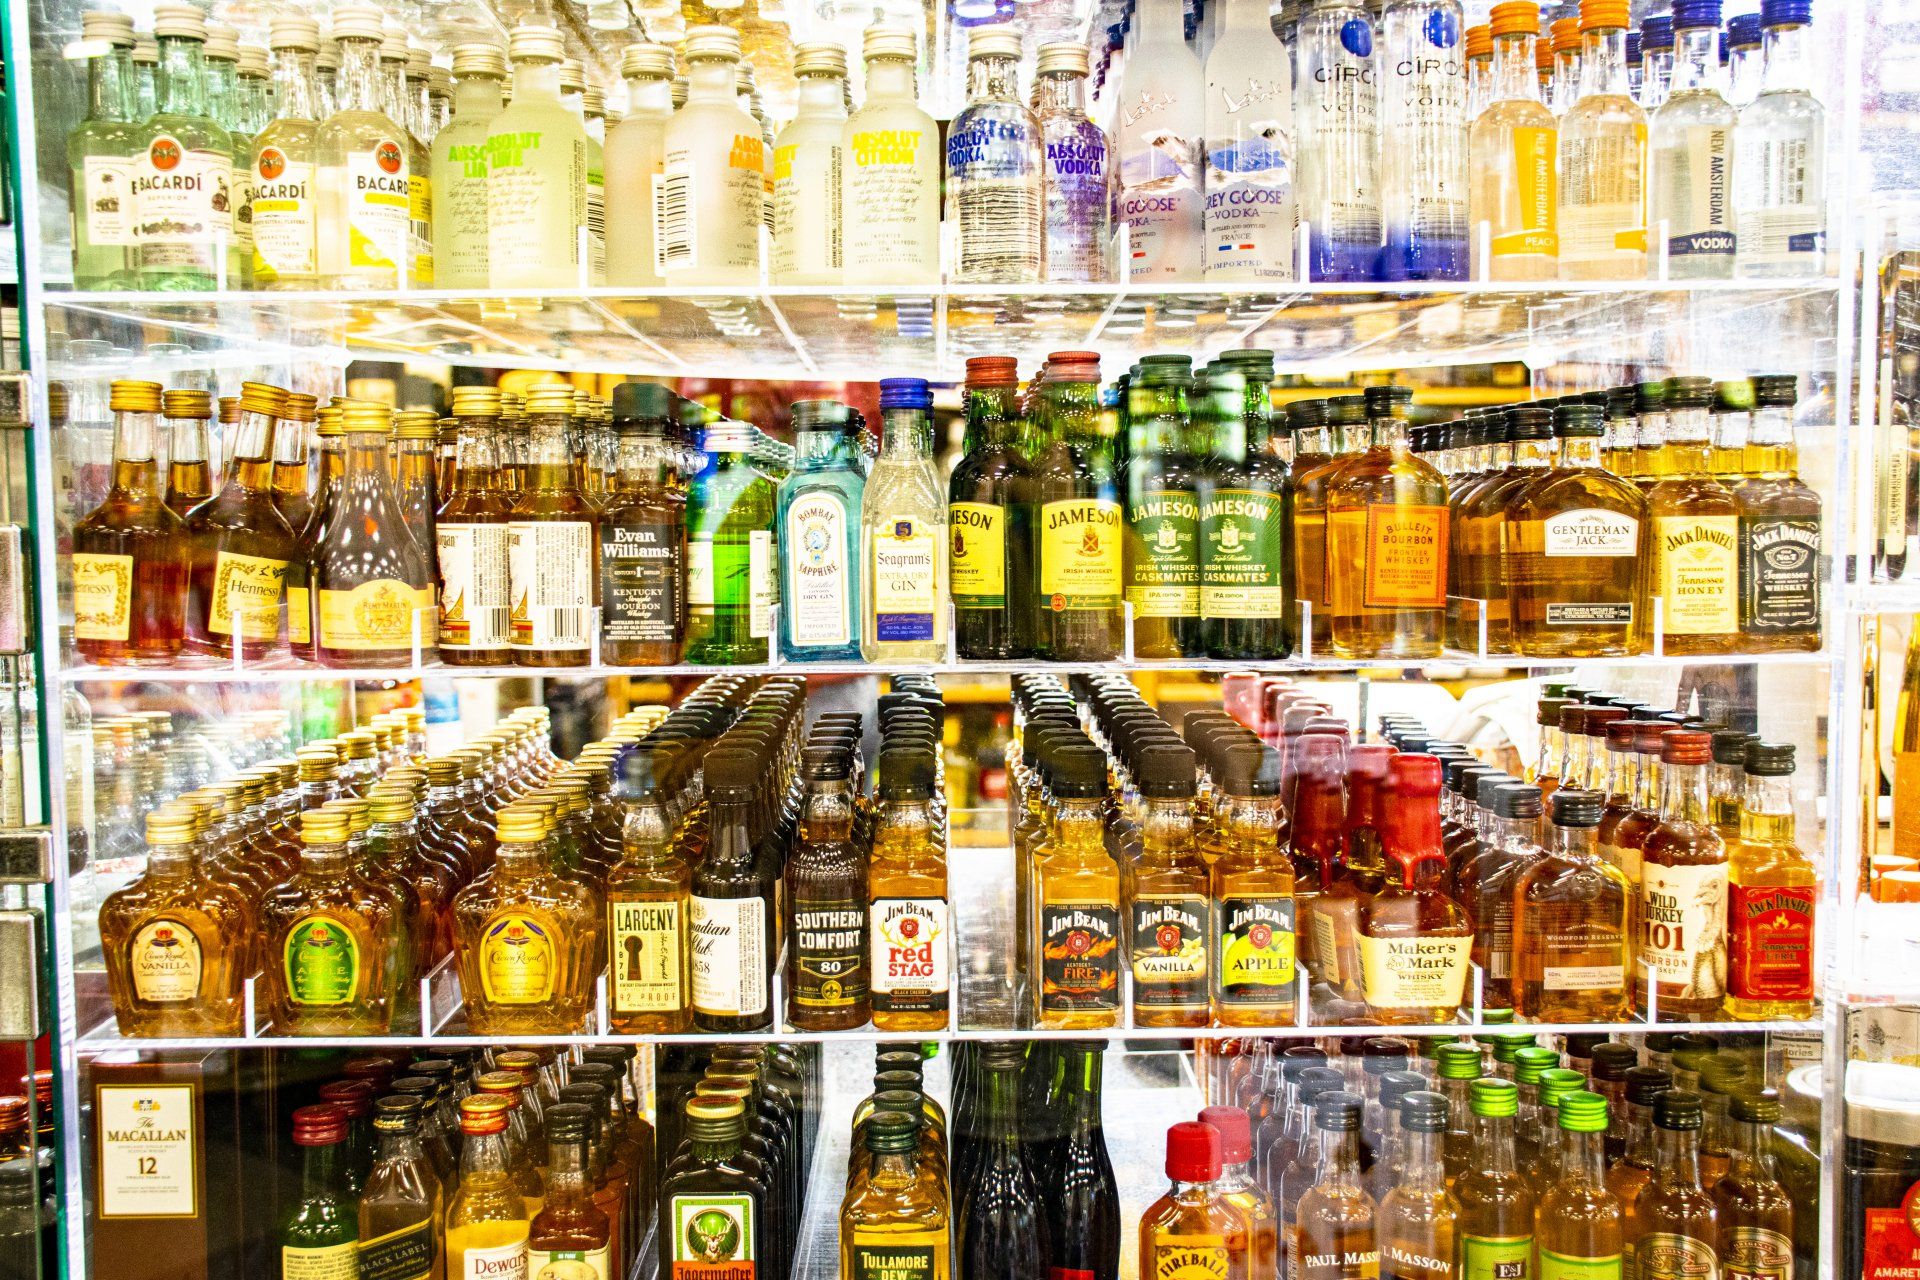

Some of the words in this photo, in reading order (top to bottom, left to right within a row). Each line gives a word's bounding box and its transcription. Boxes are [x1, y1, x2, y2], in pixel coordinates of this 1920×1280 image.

[851, 130, 922, 151] ABSOLUT
[1711, 130, 1725, 153] NEW
[448, 144, 488, 162] ABSO
[1047, 143, 1106, 162] ABSOLUT
[1055, 160, 1102, 176] VODKA
[356, 175, 408, 195] BACARD
[1710, 156, 1724, 226] AMSTERDAM
[1126, 196, 1176, 214] GOOSE
[1205, 192, 1227, 211] REY
[1229, 189, 1283, 205] GOOSE
[1214, 208, 1259, 219] VODKA
[1221, 232, 1251, 241] FRANCE
[1525, 236, 1554, 246] PEACH
[1691, 237, 1734, 250] VODKA
[1213, 260, 1262, 270] IMPORTED
[798, 508, 835, 522] BOMBAY
[1131, 501, 1200, 522] JAMESON
[1202, 500, 1269, 521] JAMESON
[1049, 508, 1119, 530] JAMESON
[614, 528, 657, 543] Evan
[1386, 522, 1432, 535] BULLEIT
[1552, 525, 1631, 535] GENTLEMAN
[1383, 536, 1433, 545] BOURBON
[1576, 536, 1607, 547] JACK
[1666, 530, 1694, 551] JACK
[1695, 525, 1734, 551] DANIEL'S
[1751, 530, 1779, 551] JACK
[1779, 524, 1820, 549] DANIEL'S
[878, 552, 931, 568] Seagram's
[1386, 557, 1430, 565] WHISKEY
[799, 561, 839, 576] SAPPHIRE
[1763, 570, 1809, 580] Tennessee
[880, 572, 907, 580] EXTRA
[911, 572, 929, 580] DRY
[1135, 572, 1200, 582] CASKMATES
[1203, 572, 1268, 583] CASKMATES
[1677, 574, 1724, 585] Tennessee
[613, 589, 664, 597] KENTUCKY
[891, 581, 917, 592] GIN
[1677, 586, 1724, 595] HONEY
[1764, 584, 1808, 592] WHISKEY
[616, 603, 661, 611] BOURBON
[368, 611, 402, 632] 1738
[1649, 891, 1677, 909] WILD
[885, 904, 904, 922] JIM
[906, 902, 933, 922] BEAM
[1645, 901, 1684, 923] TURKEY
[1747, 899, 1774, 918] JACK
[618, 909, 673, 931] LARCENY
[795, 911, 863, 930] SOUTHERN
[1048, 915, 1073, 938] JIM
[1073, 911, 1109, 937] BEAM
[1138, 910, 1162, 932] JIM
[1163, 906, 1199, 932] BEAM
[1229, 909, 1254, 932] JIM
[1255, 904, 1290, 930] BEAM
[799, 930, 860, 950] COMFORT
[1257, 932, 1264, 940] B
[1591, 933, 1623, 941] RESERVE
[1644, 921, 1685, 951] 101
[889, 941, 933, 962] red
[1387, 943, 1457, 955] Maker's
[491, 951, 515, 964] Crown
[514, 951, 545, 965] Royal
[1407, 957, 1454, 969] Mark
[1766, 953, 1796, 961] FIRE
[141, 962, 191, 970] VANILLA
[820, 962, 841, 973] 80
[889, 963, 934, 977] STAG
[1143, 963, 1194, 972] VANILLA
[1232, 958, 1289, 971] APPLE
[1064, 968, 1095, 979] FIRE
[619, 993, 632, 1001] 92
[137, 1117, 154, 1128] The
[107, 1130, 186, 1142] MACALLAN
[138, 1156, 157, 1174] 12
[360, 1256, 392, 1272] BLACK
[395, 1243, 429, 1259] LABEL
[861, 1252, 929, 1270] TULLAMORE
[1305, 1254, 1340, 1268] PAUL
[1391, 1247, 1451, 1274] MASSON
[1159, 1253, 1224, 1278] FIREBALL
[1500, 1263, 1522, 1278] E&J
